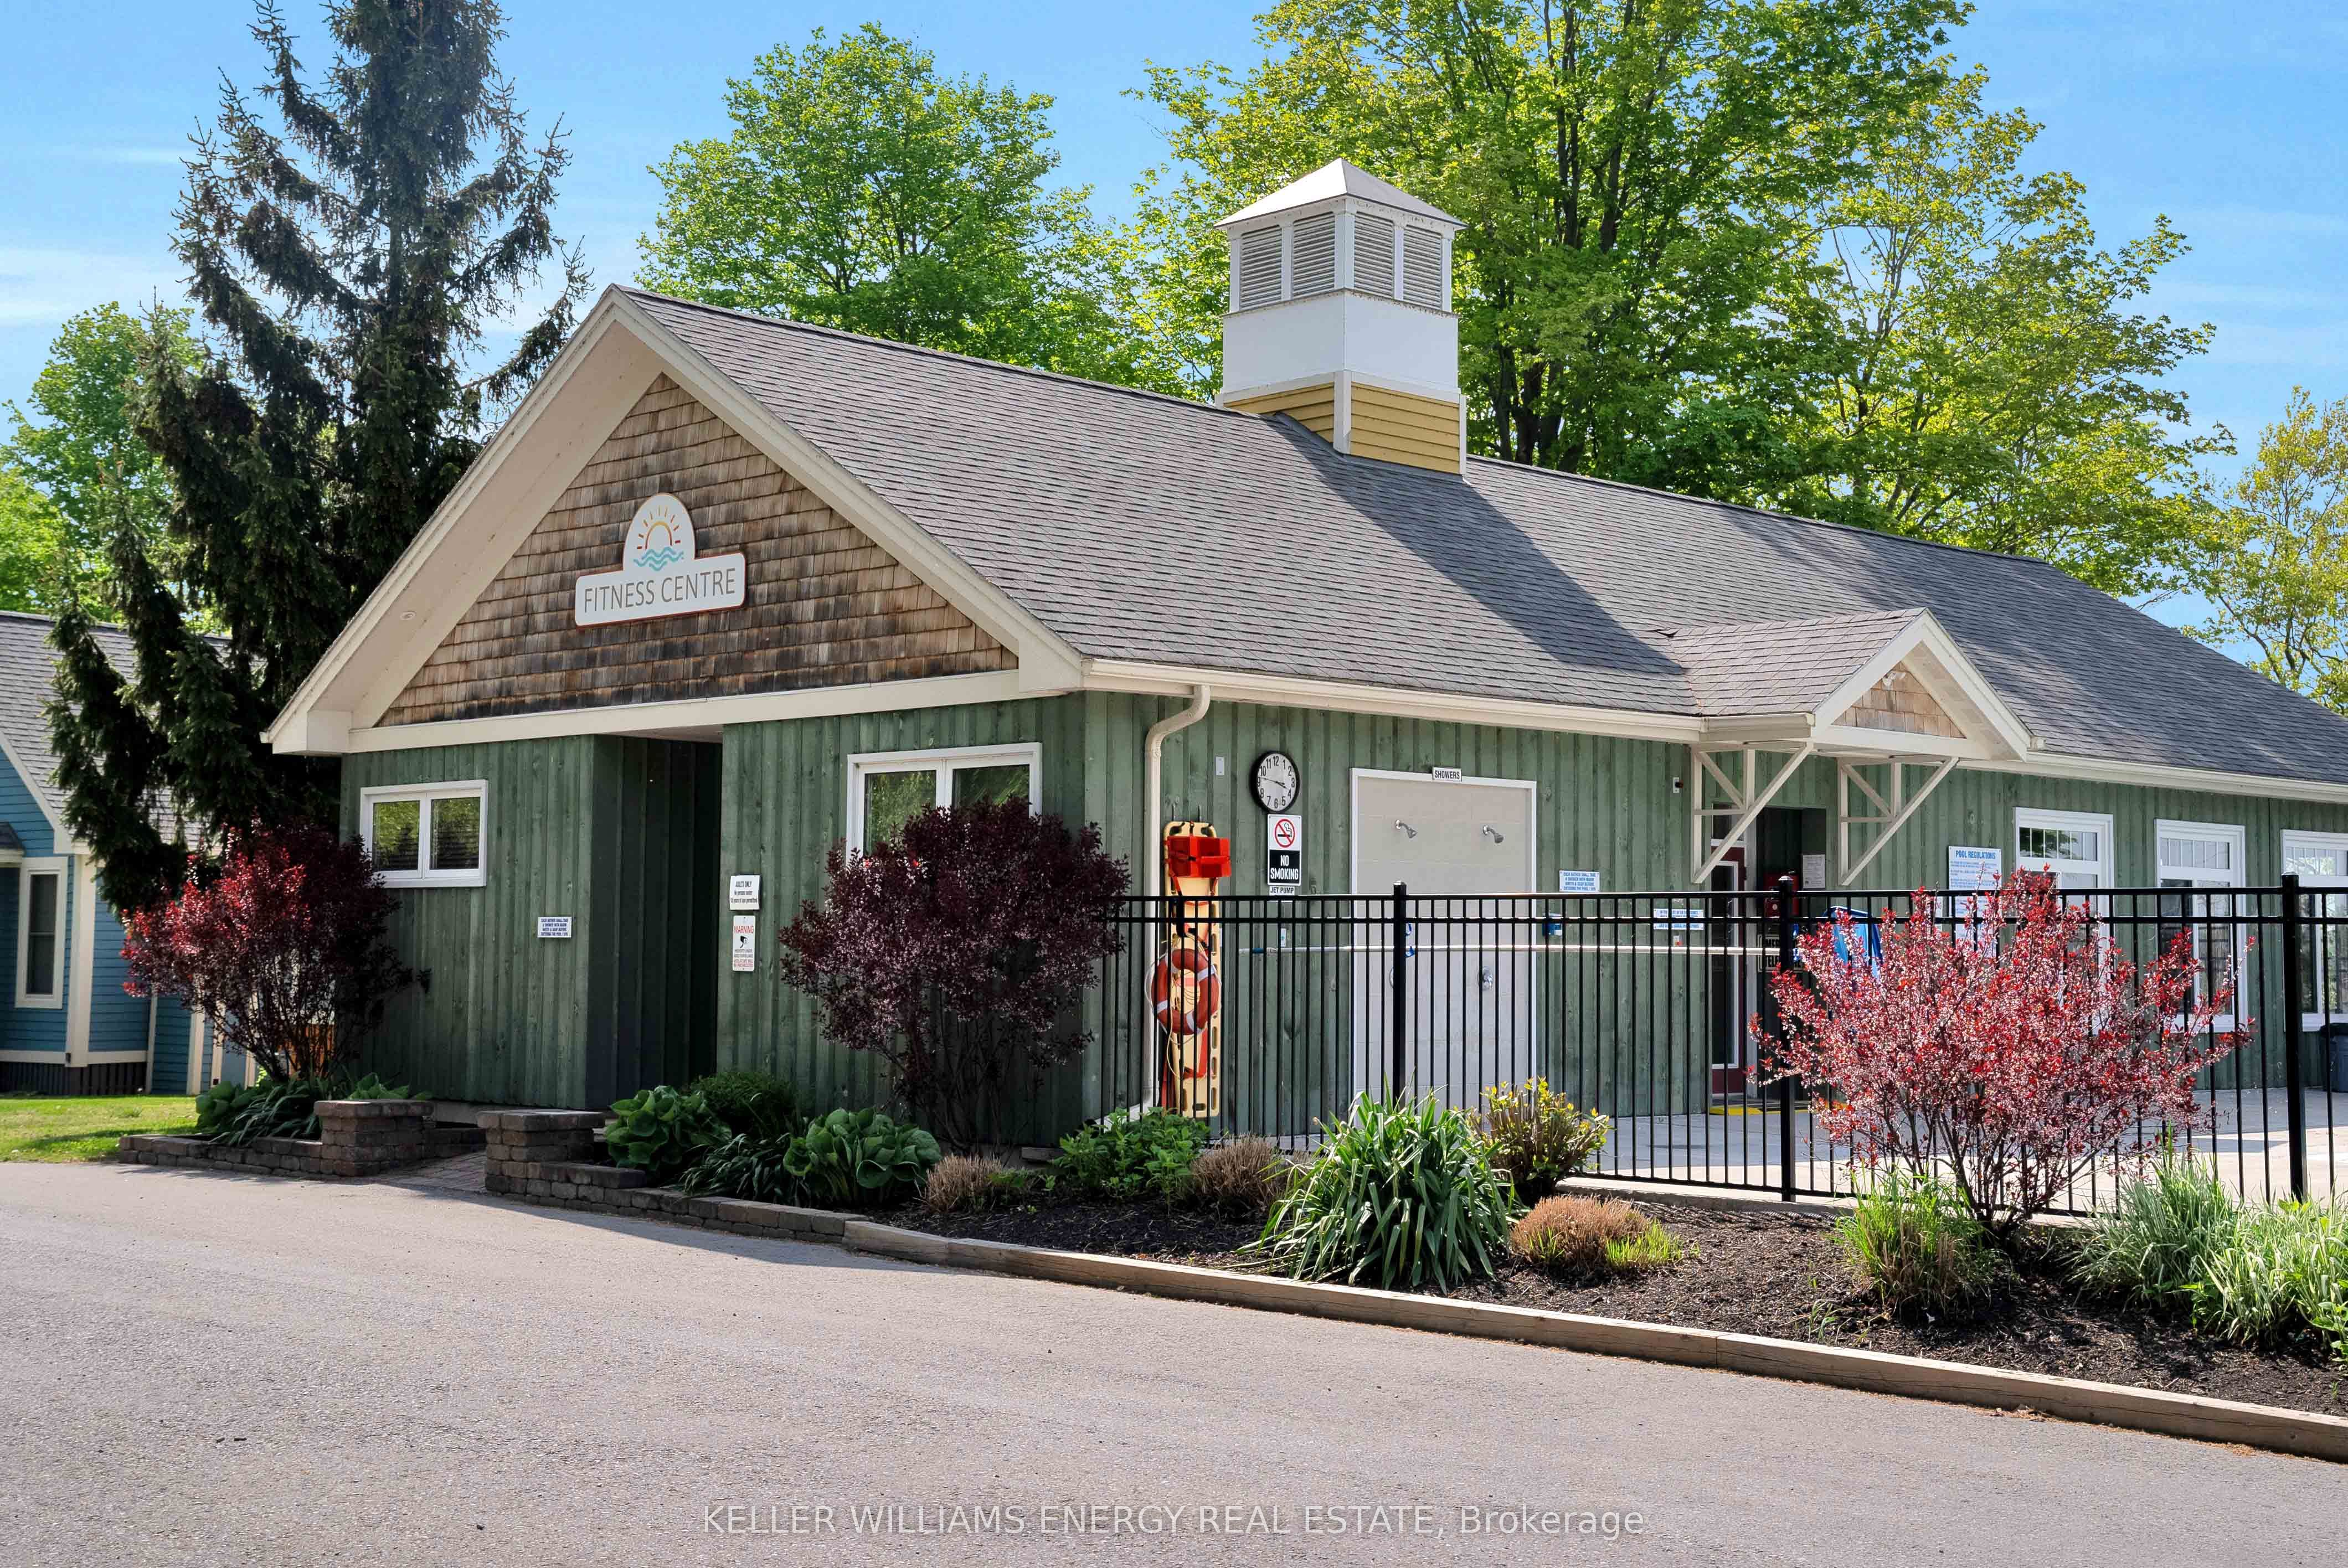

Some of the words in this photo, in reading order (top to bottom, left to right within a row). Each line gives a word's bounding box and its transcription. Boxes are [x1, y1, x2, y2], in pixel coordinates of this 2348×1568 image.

[584, 580, 655, 613] FITNESS
[661, 568, 735, 602] CENTRE
[1266, 759, 1271, 769] 11
[1273, 756, 1279, 766] 12
[1283, 760, 1286, 770] 1
[1260, 766, 1266, 776] 10
[1288, 766, 1292, 776] 2
[1434, 770, 1460, 780] SHOWERS
[1258, 777, 1261, 787] 9
[1291, 777, 1295, 787] 3
[1260, 788, 1264, 798] 8
[1288, 788, 1291, 799] 4
[1266, 796, 1271, 806] 7
[1274, 798, 1278, 808] 6
[1282, 796, 1286, 806] 5
[1955, 850, 1968, 858] POOL
[1968, 850, 1996, 859] REGULATIONS
[1280, 855, 1289, 866] NO
[1270, 868, 1299, 880] SMOKING
[734, 925, 754, 934] WARNING
